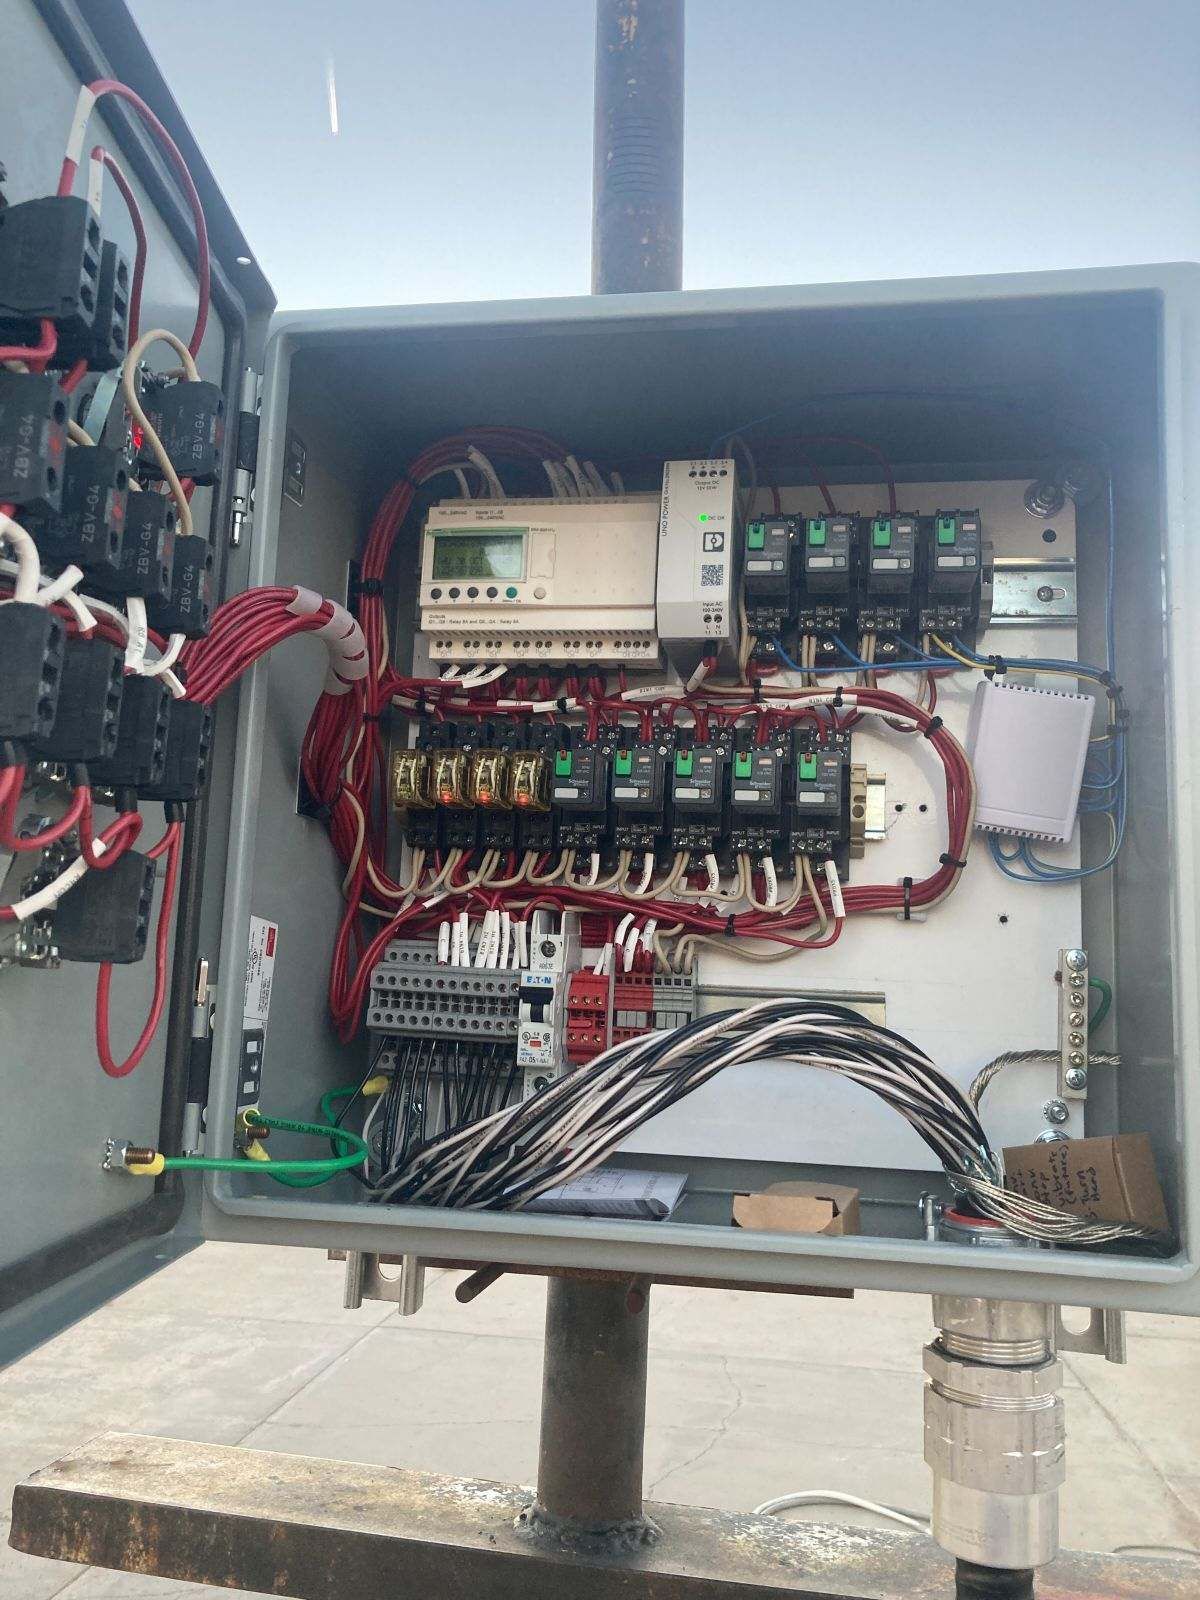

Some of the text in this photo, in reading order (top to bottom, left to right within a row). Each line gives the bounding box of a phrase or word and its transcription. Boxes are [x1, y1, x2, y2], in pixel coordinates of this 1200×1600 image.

[193, 412, 205, 460] ZBV-G4
[80, 484, 100, 543] ZBV-G4
[137, 522, 153, 575] ZBV-G4
[180, 565, 194, 613] ZBV-G4
